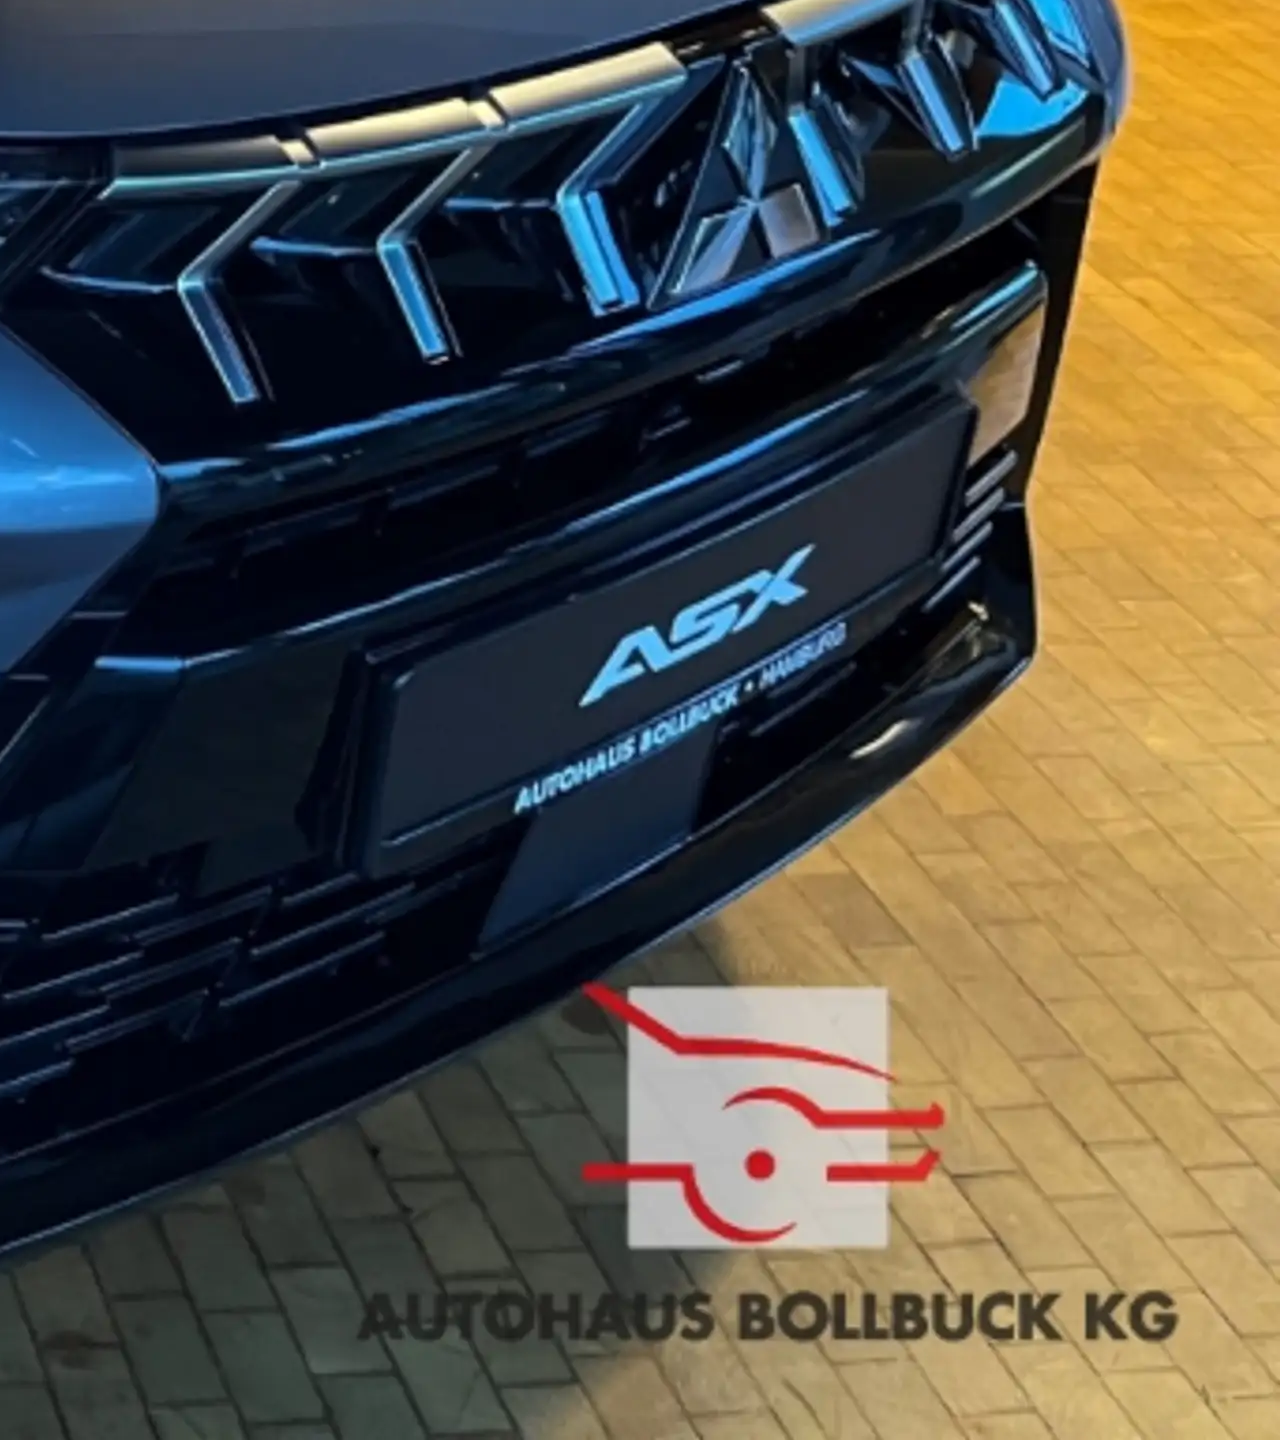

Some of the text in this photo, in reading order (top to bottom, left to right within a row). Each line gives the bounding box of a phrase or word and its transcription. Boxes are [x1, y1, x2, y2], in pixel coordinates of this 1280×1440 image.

[579, 544, 816, 707] ASX
[513, 622, 848, 815] AUTOHAUS BOLLBUCK HAMBURG
